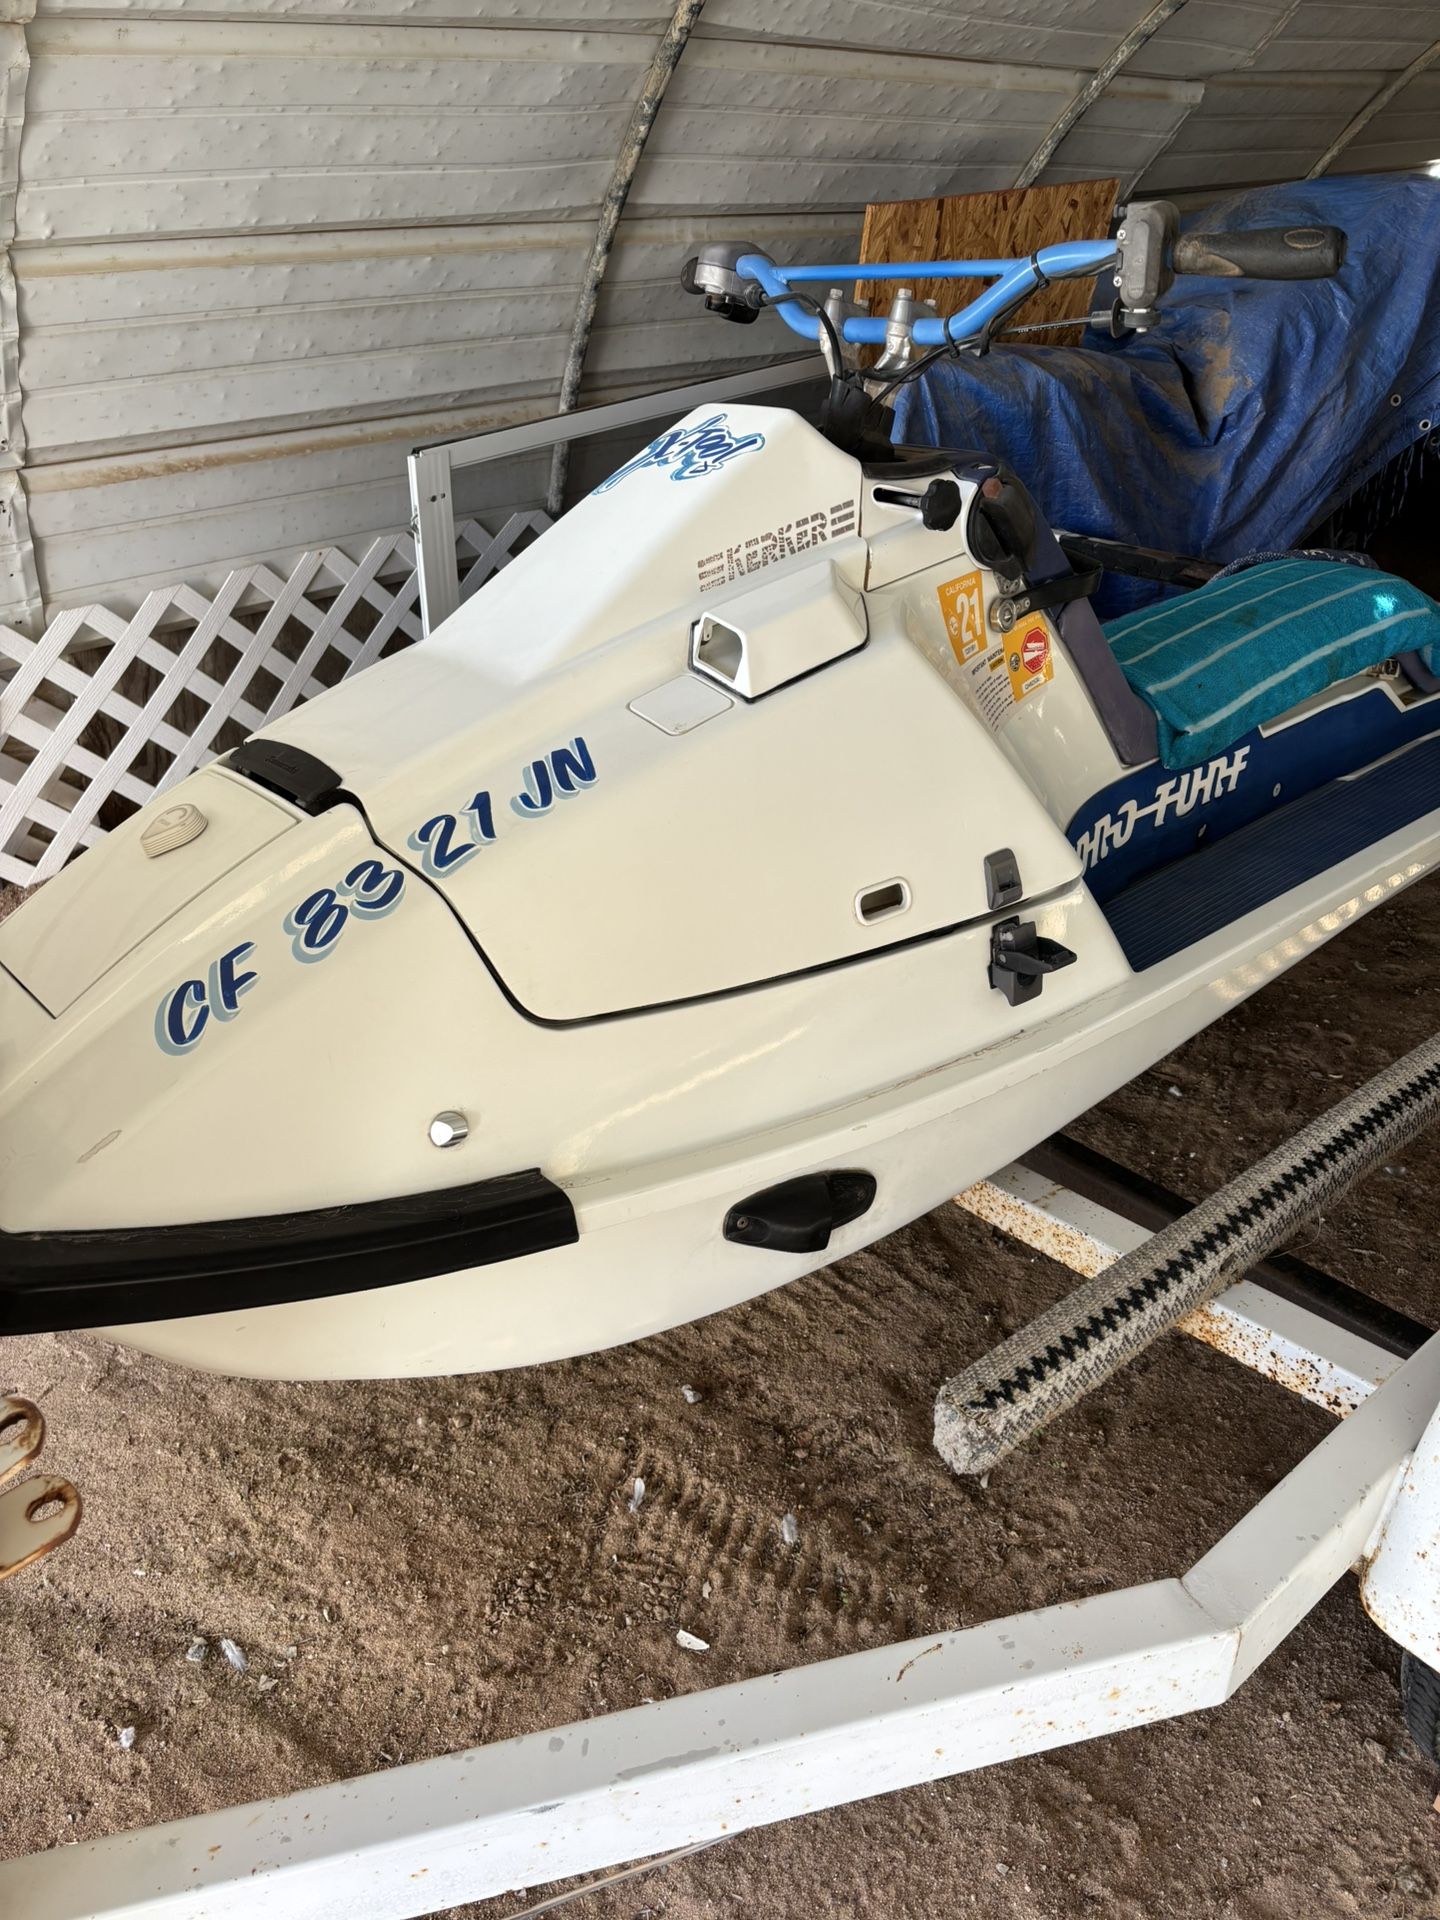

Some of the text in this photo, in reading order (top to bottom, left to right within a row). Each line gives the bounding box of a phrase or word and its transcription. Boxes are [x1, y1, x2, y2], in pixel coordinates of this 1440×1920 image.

[945, 577, 977, 597] CALIFORNIA
[956, 588, 983, 645] 21
[154, 736, 599, 1056] CF 83 21 JN
